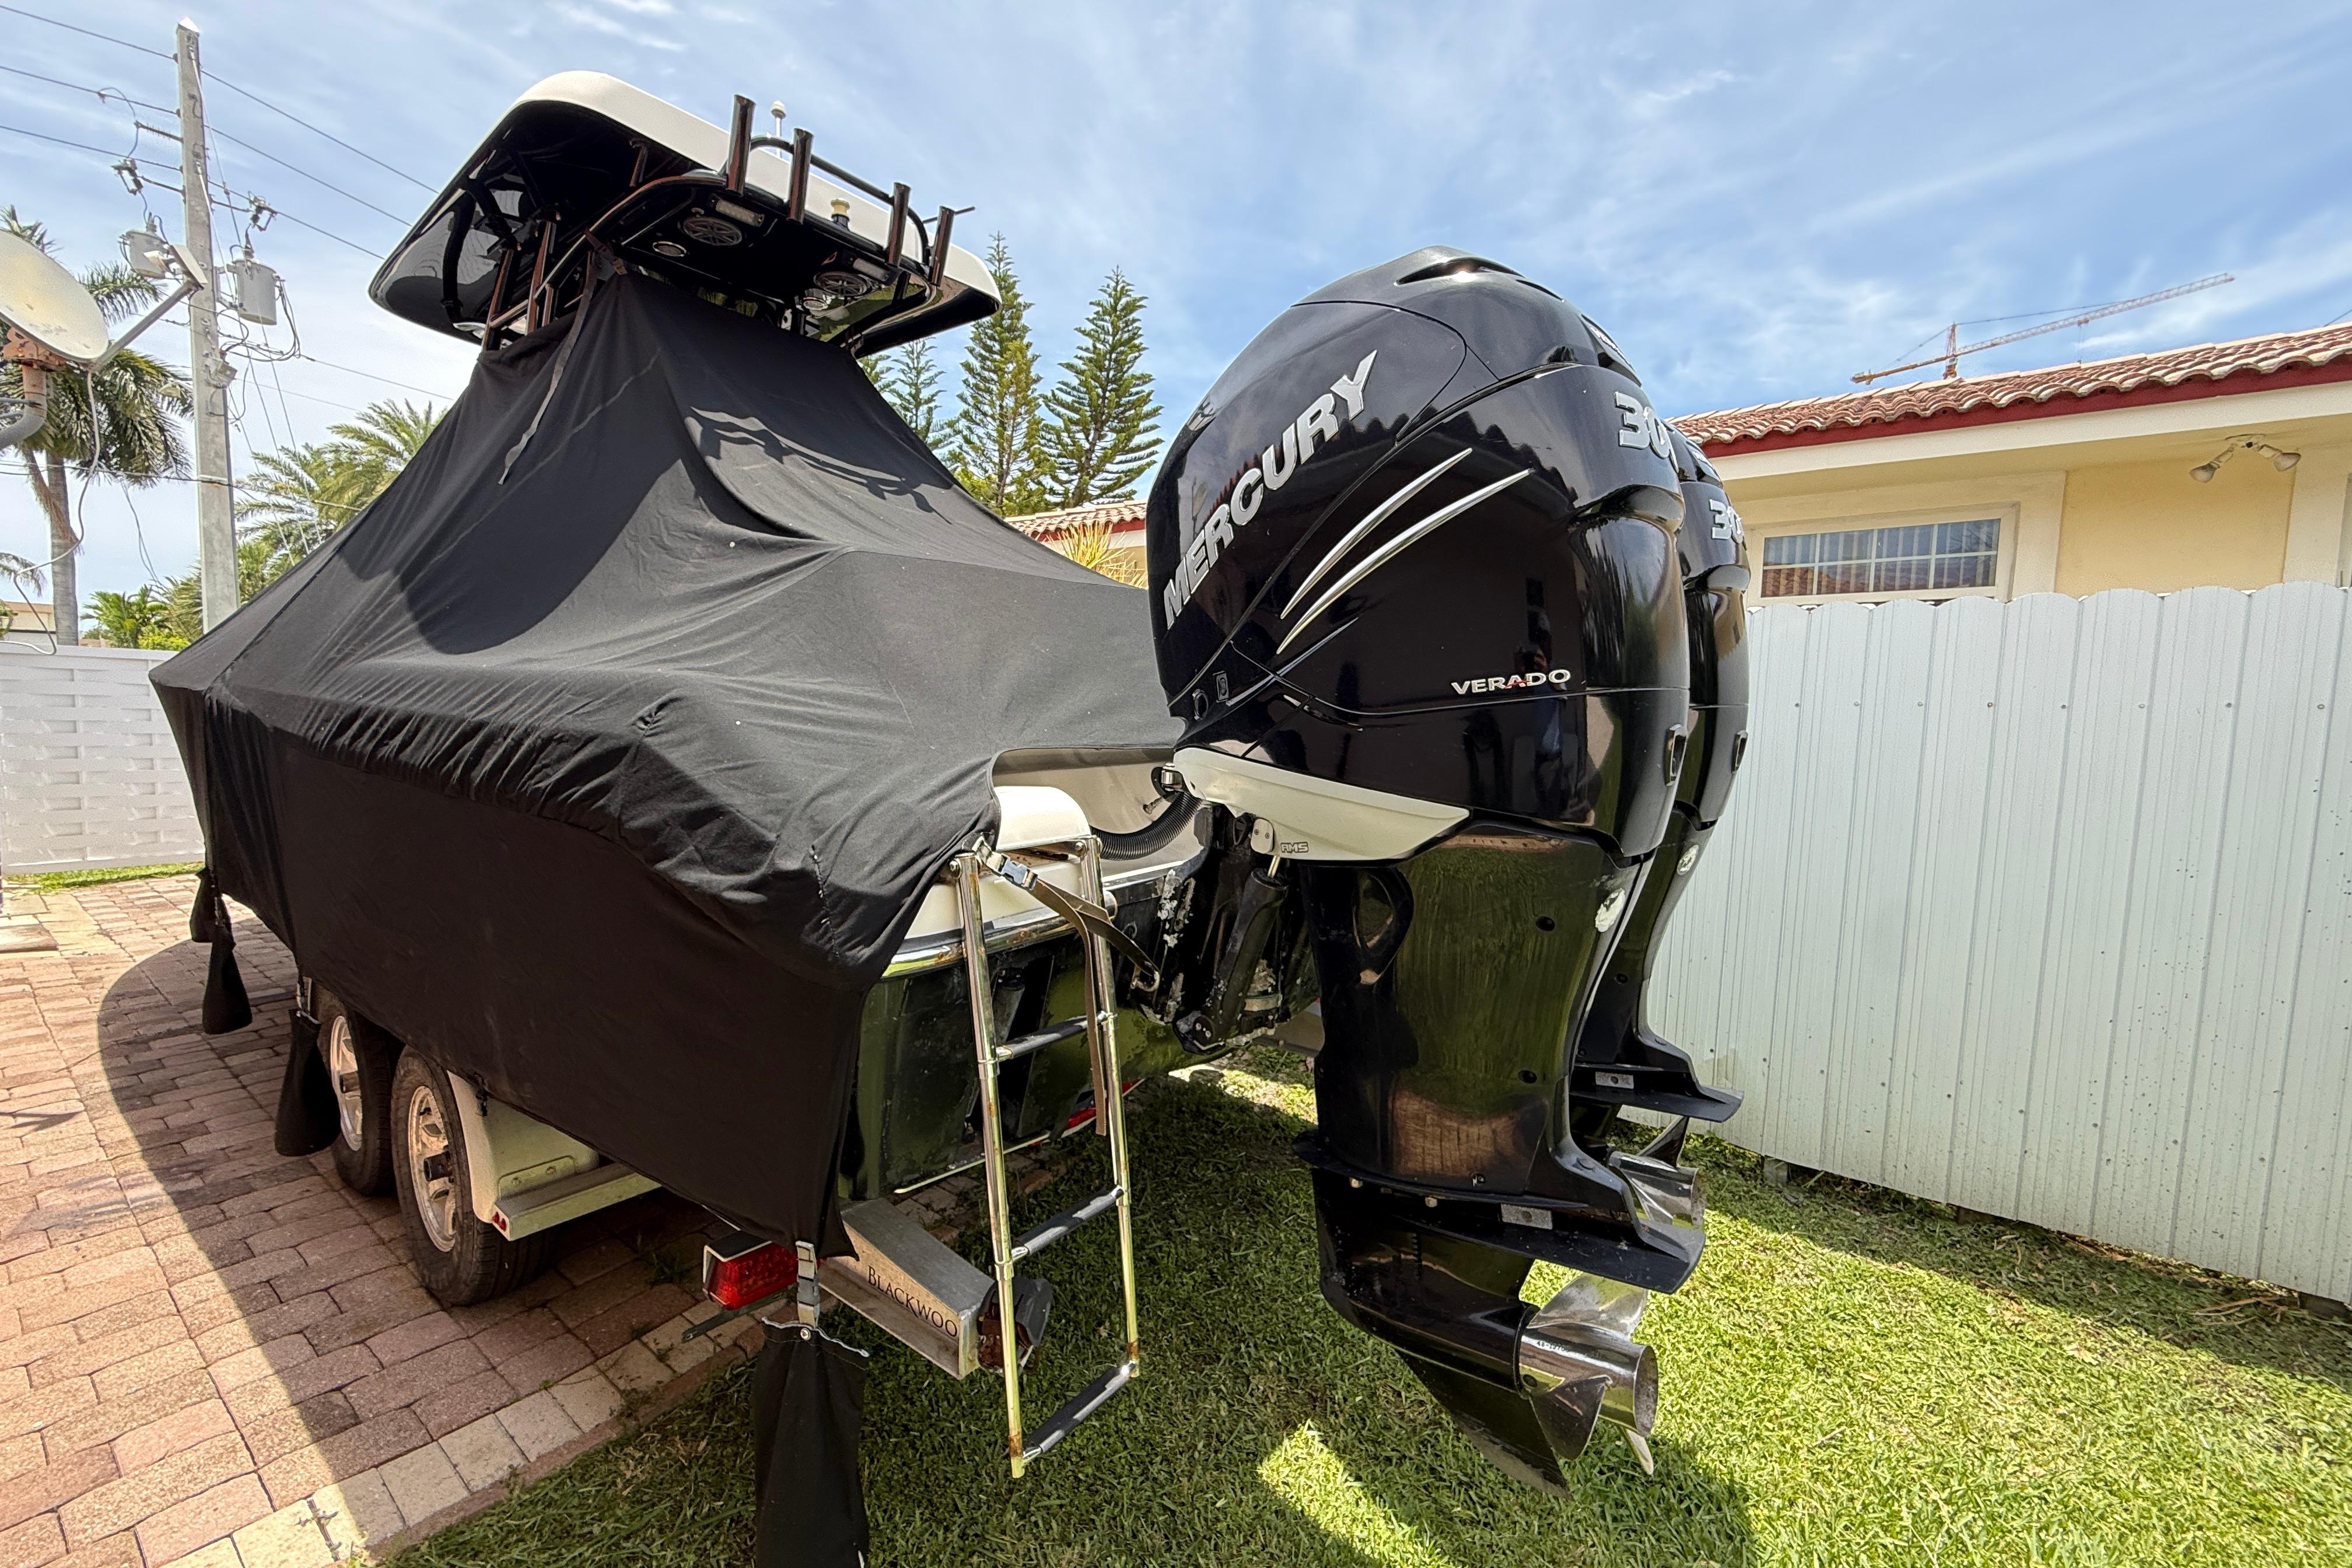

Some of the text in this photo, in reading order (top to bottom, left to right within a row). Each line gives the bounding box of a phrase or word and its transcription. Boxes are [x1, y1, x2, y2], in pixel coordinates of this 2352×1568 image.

[1614, 391, 1679, 473] 30
[1164, 350, 1377, 630] MERCURY
[1451, 669, 1571, 695] VERADO
